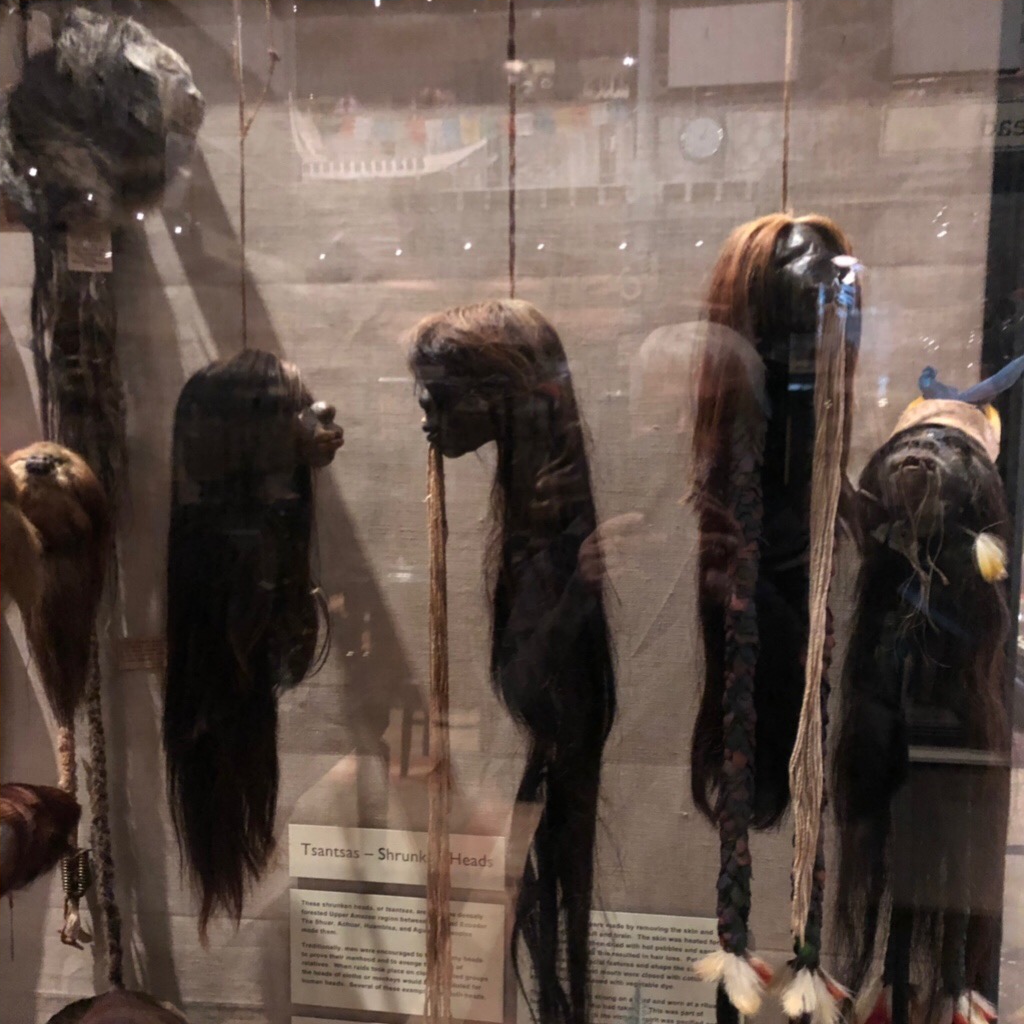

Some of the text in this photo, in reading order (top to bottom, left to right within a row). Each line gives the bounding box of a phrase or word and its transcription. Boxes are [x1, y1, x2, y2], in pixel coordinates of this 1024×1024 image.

[300, 842, 360, 859] Tsantsas
[378, 847, 427, 863] Shrunk
[450, 852, 494, 868] Heads
